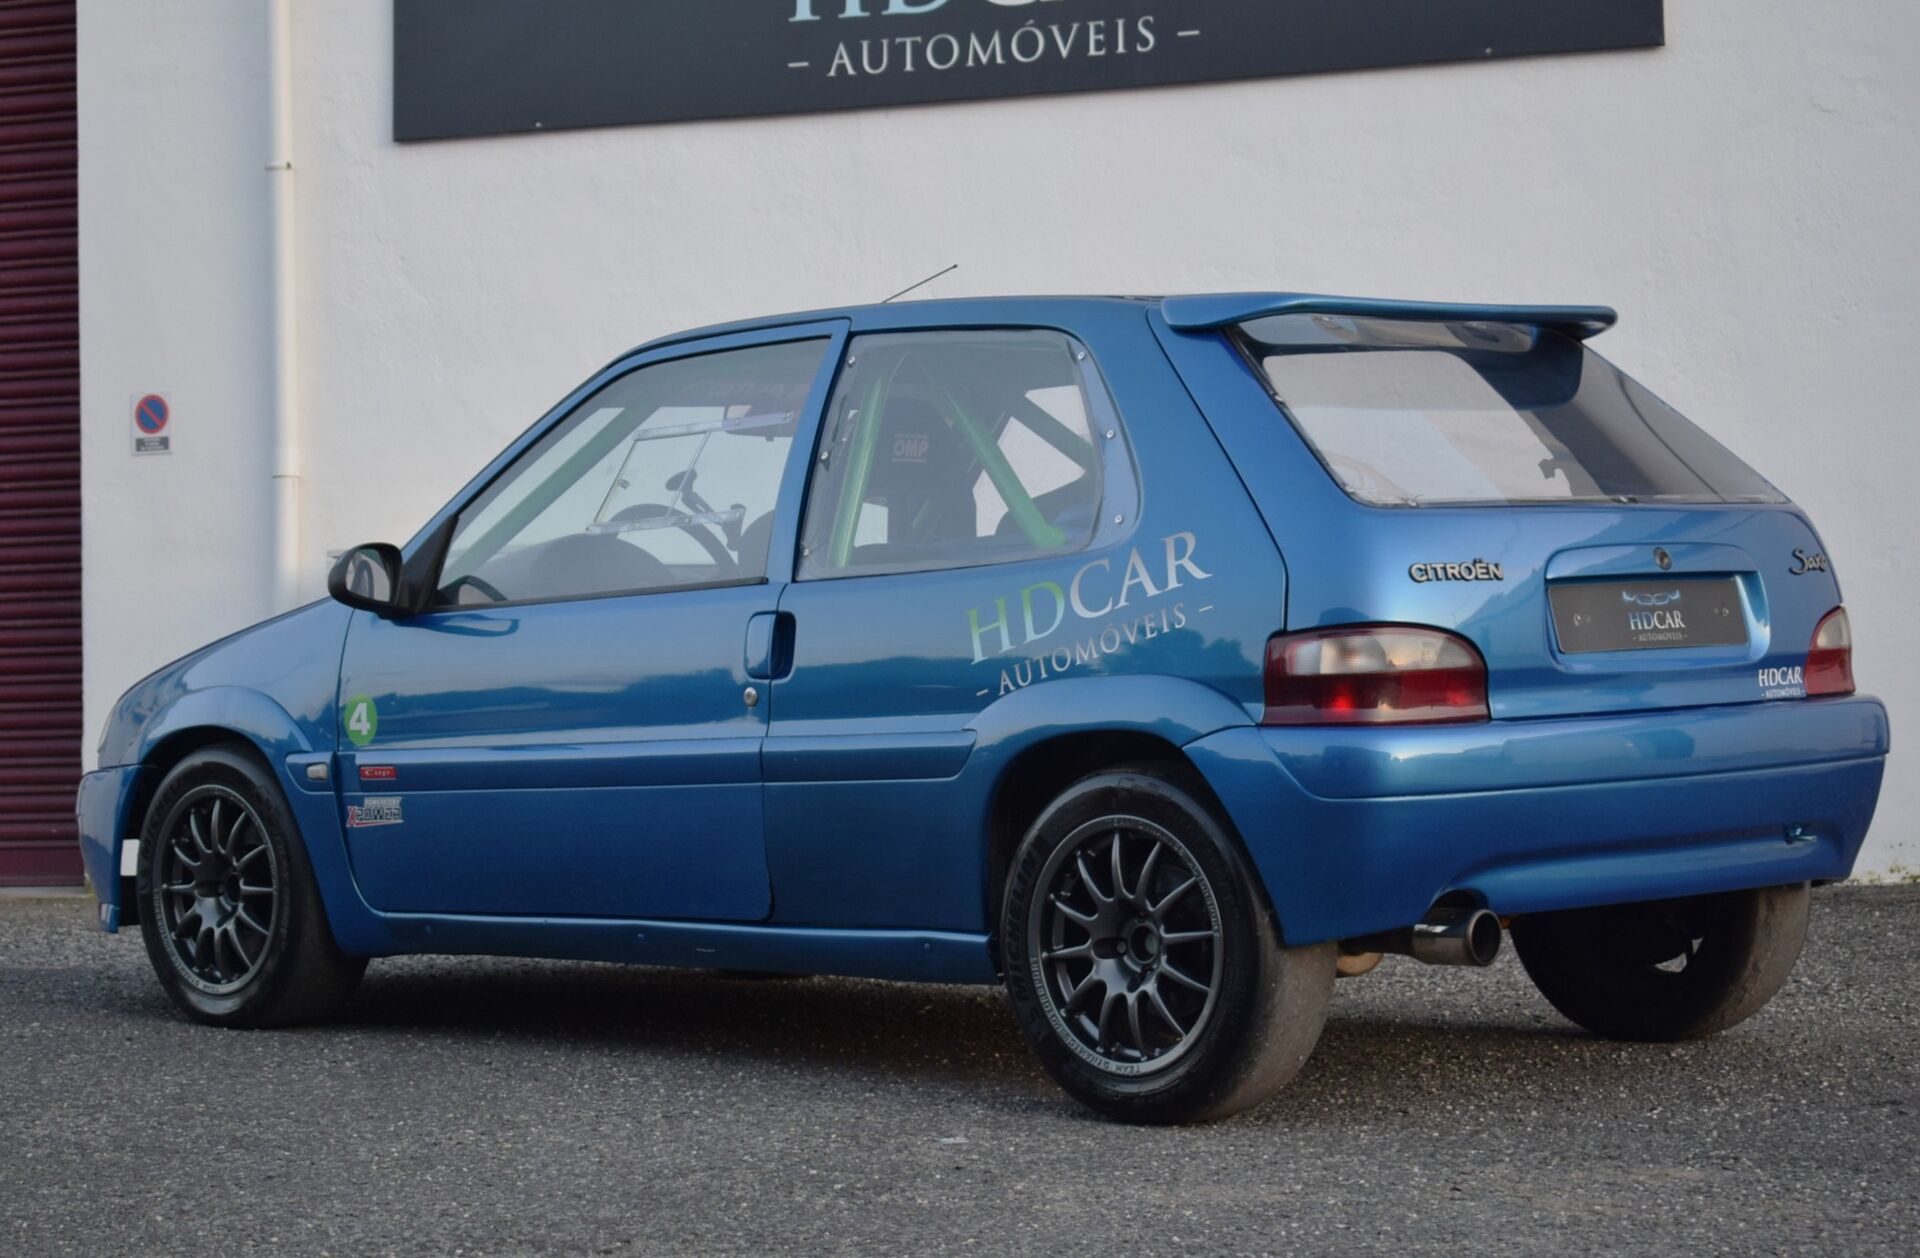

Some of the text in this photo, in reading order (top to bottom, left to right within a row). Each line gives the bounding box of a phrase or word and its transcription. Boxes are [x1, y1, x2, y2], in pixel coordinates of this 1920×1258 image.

[826, 16, 1156, 77] AUTOMÓVEIS
[894, 439, 928, 457] OMP
[1408, 558, 1504, 583] CITROËN
[1788, 547, 1826, 575] Saxo
[965, 531, 1213, 665] HDCAR
[1628, 610, 1686, 630] HDCAR
[998, 602, 1186, 695] AUTOMÓVEIS
[1758, 665, 1803, 687] HDCAR
[349, 702, 371, 736] 4
[364, 769, 391, 777] Cup
[1006, 849, 1042, 1008] MICHELIN
[1114, 1061, 1141, 1074] TEAM
